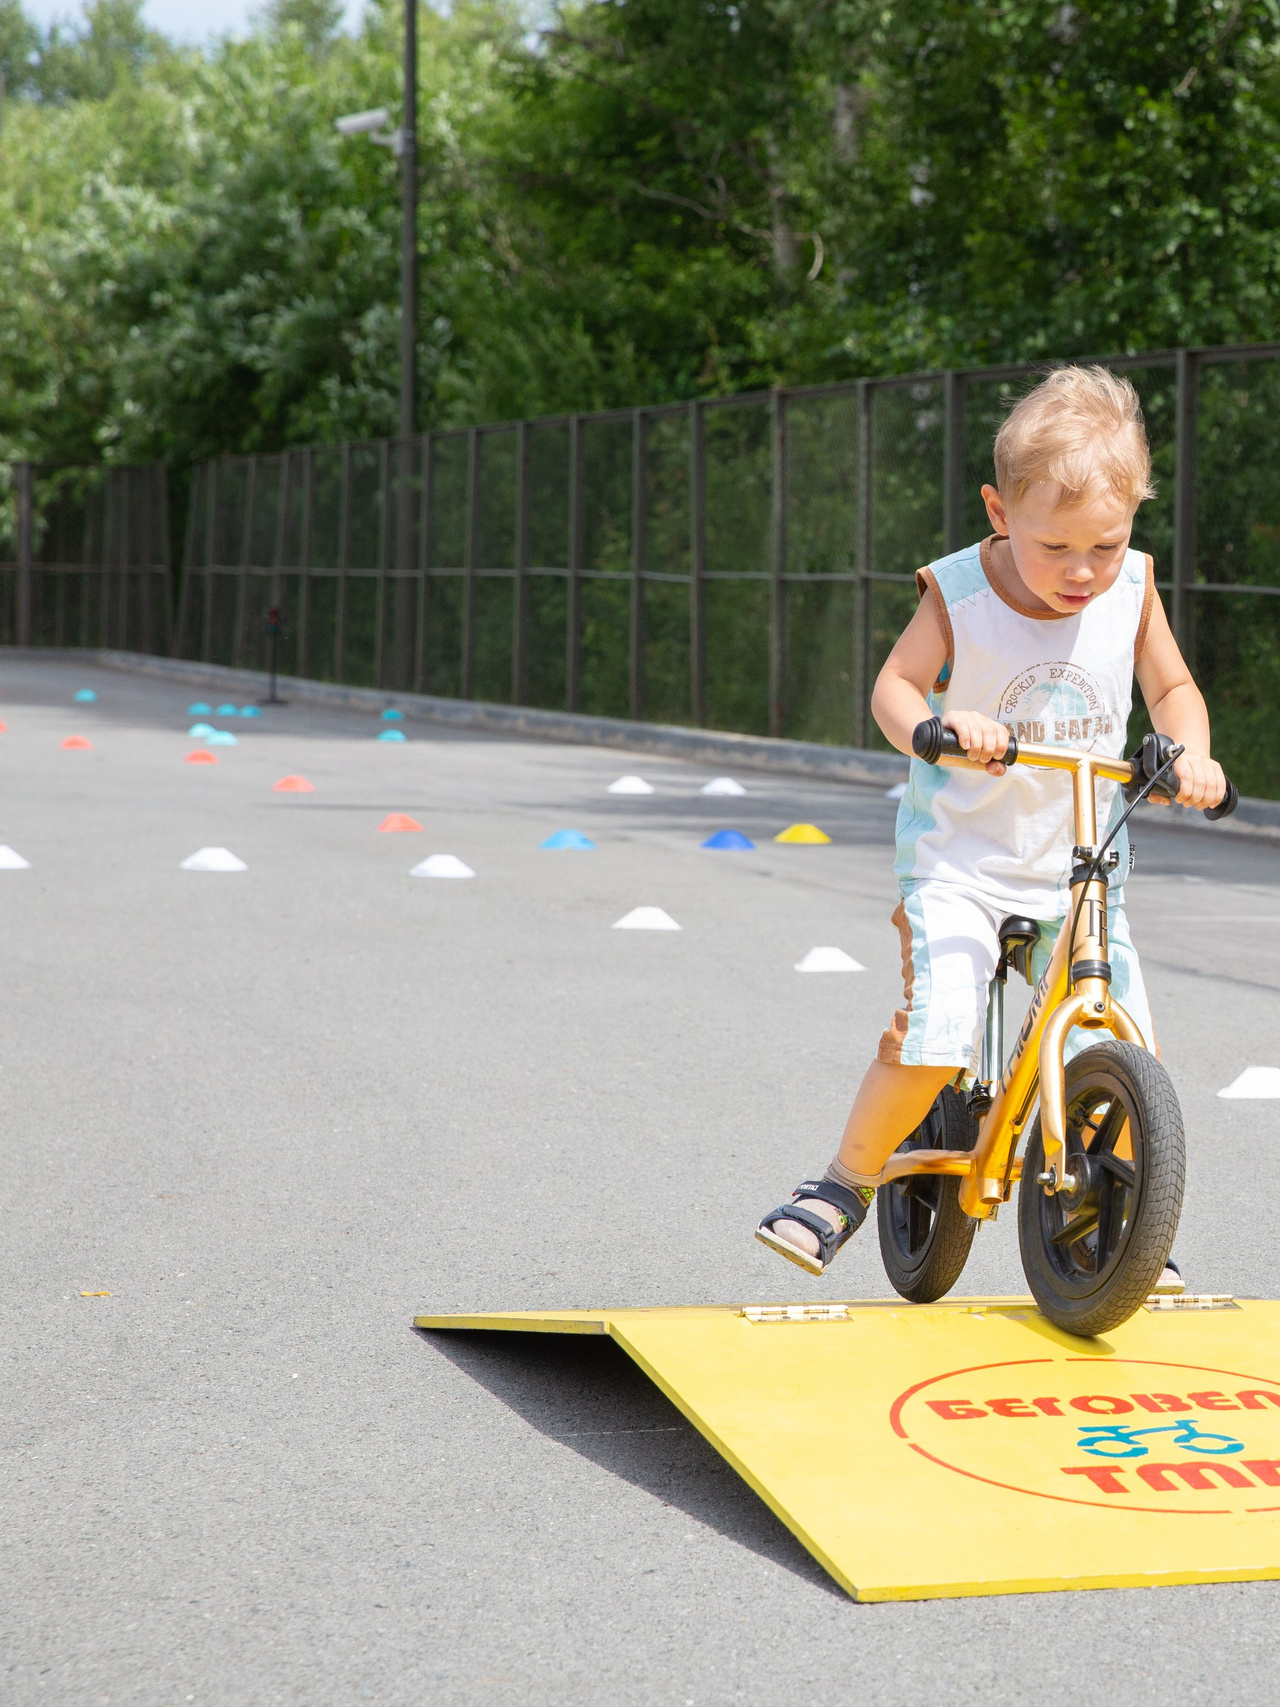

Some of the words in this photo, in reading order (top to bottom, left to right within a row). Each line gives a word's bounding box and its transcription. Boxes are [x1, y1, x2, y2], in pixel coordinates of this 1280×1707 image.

[1004, 674, 1037, 714] CROCKID
[1048, 668, 1099, 712] EXPEDITION
[1003, 720, 1045, 744] AND
